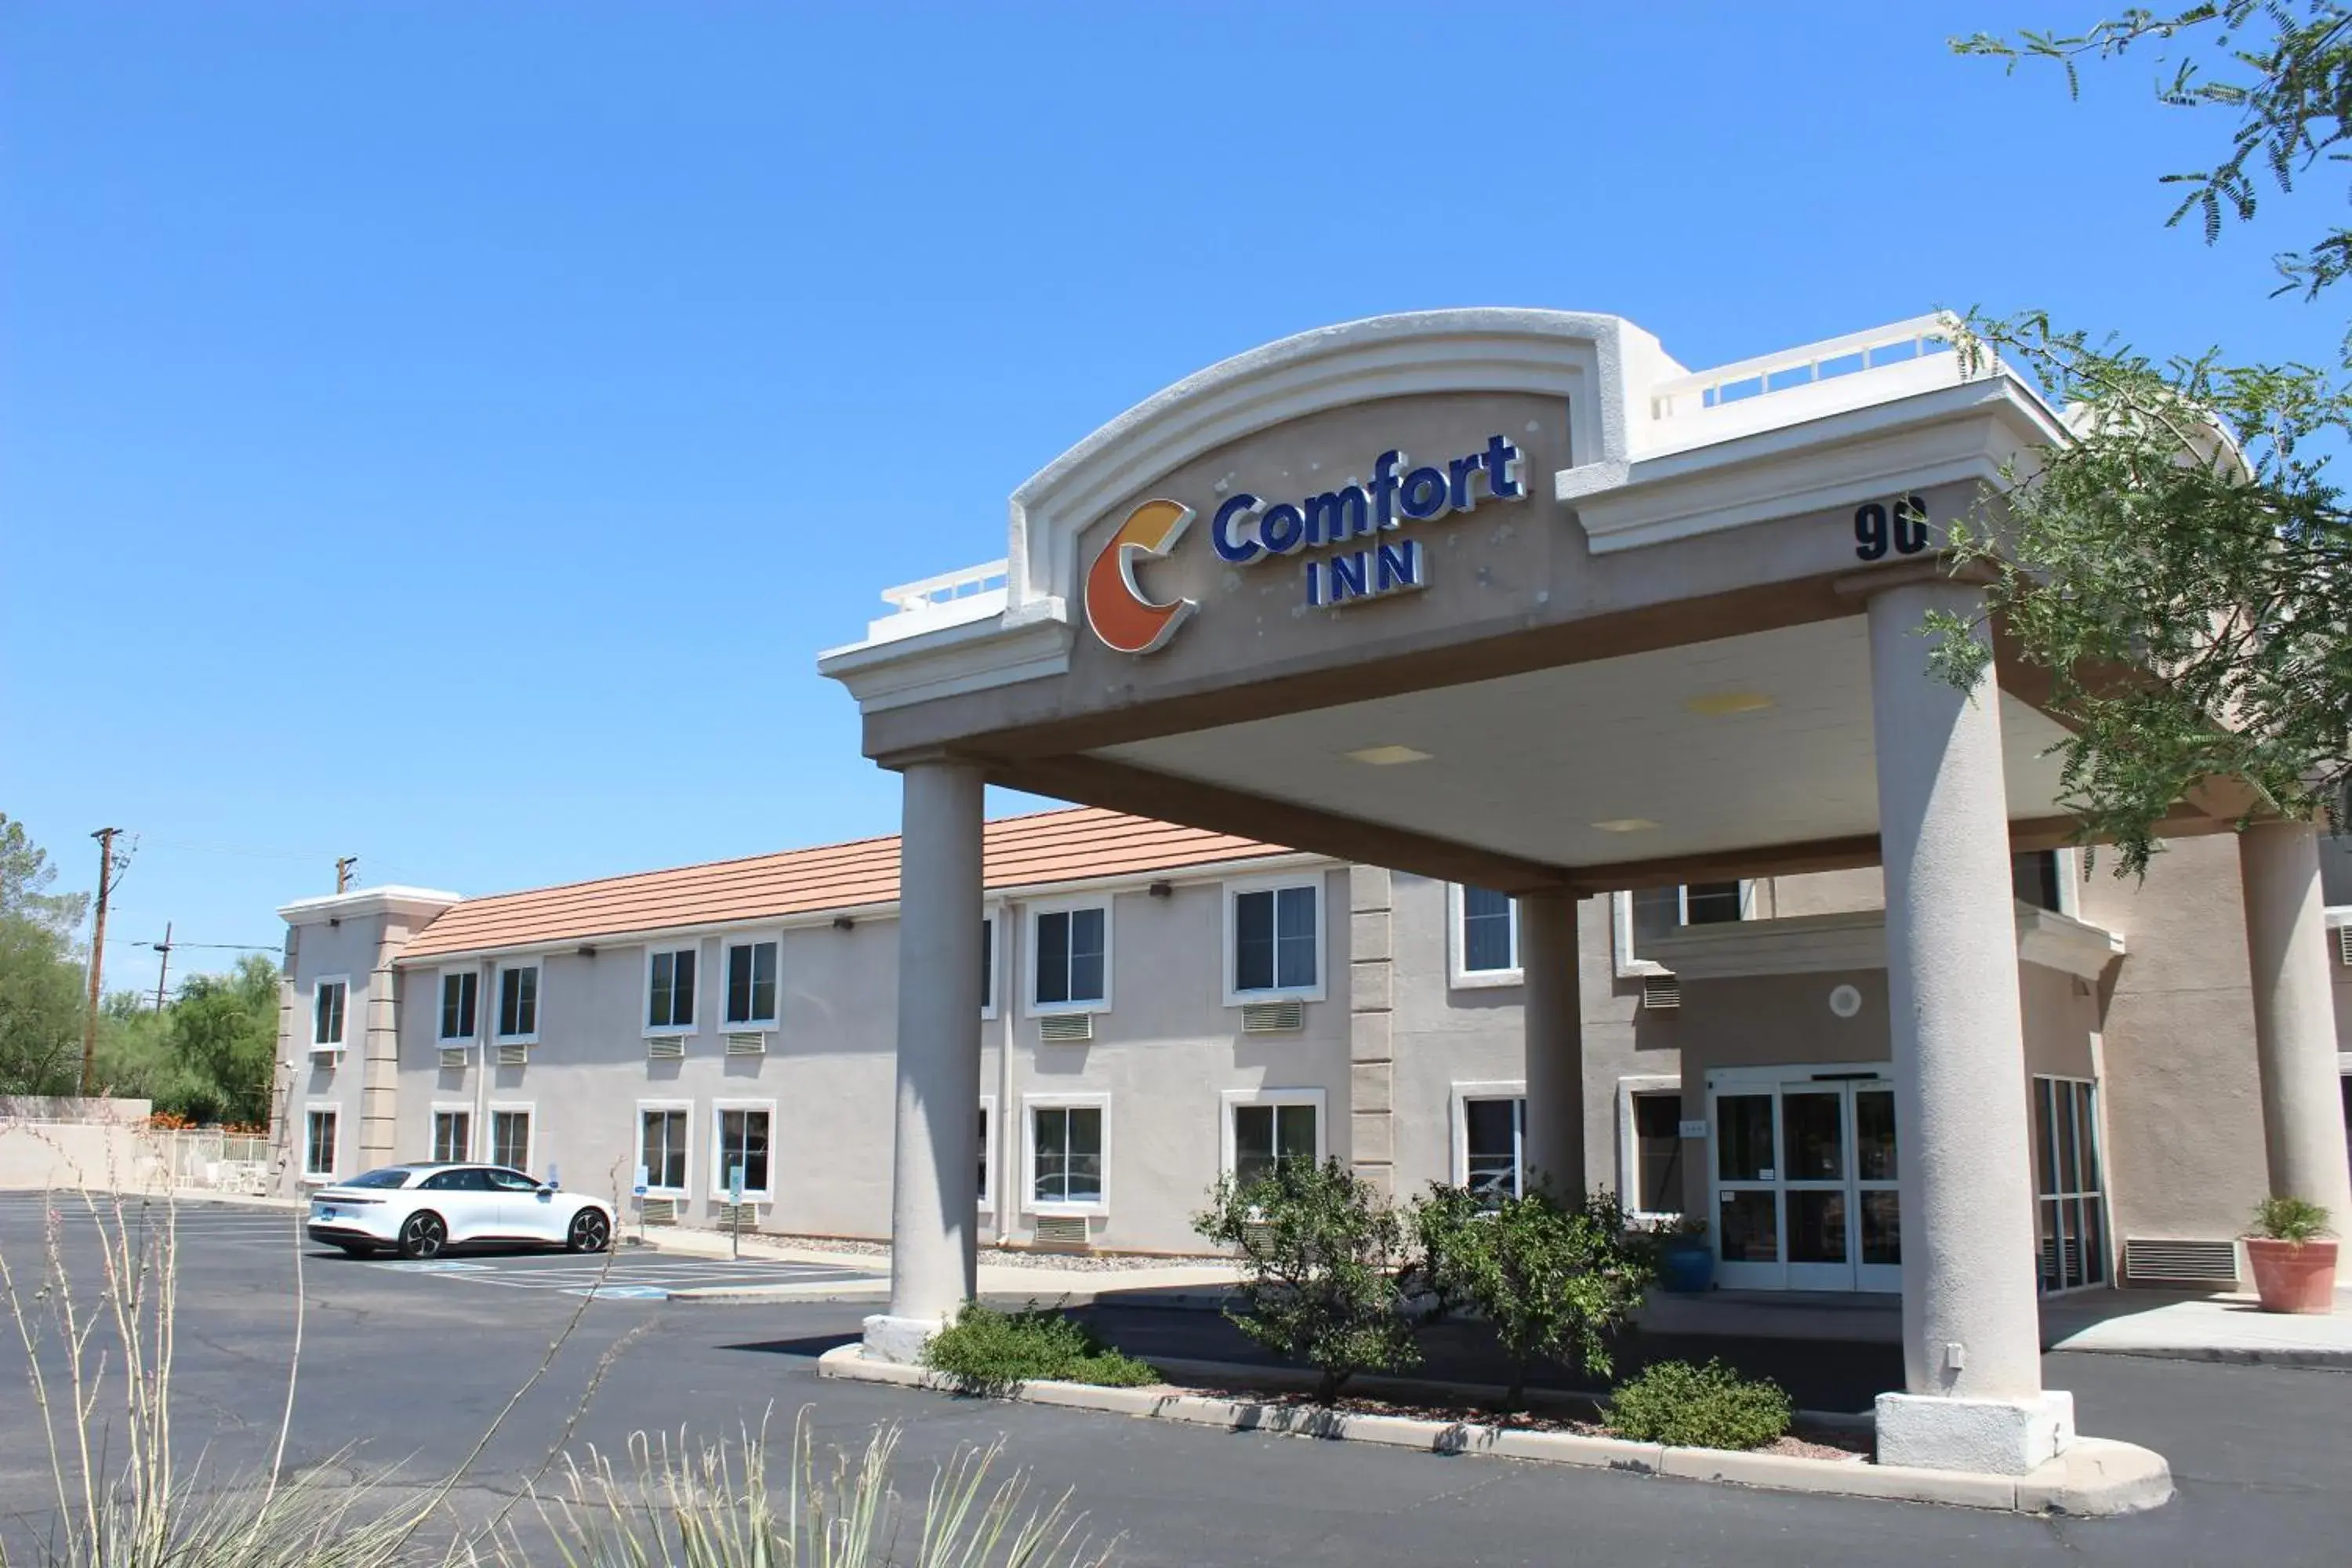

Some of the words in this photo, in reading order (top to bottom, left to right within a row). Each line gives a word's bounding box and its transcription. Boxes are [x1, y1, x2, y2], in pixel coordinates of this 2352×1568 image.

[1212, 434, 1524, 564] Comfort
[1855, 496, 1927, 561] 90
[1306, 539, 1420, 607] INN
